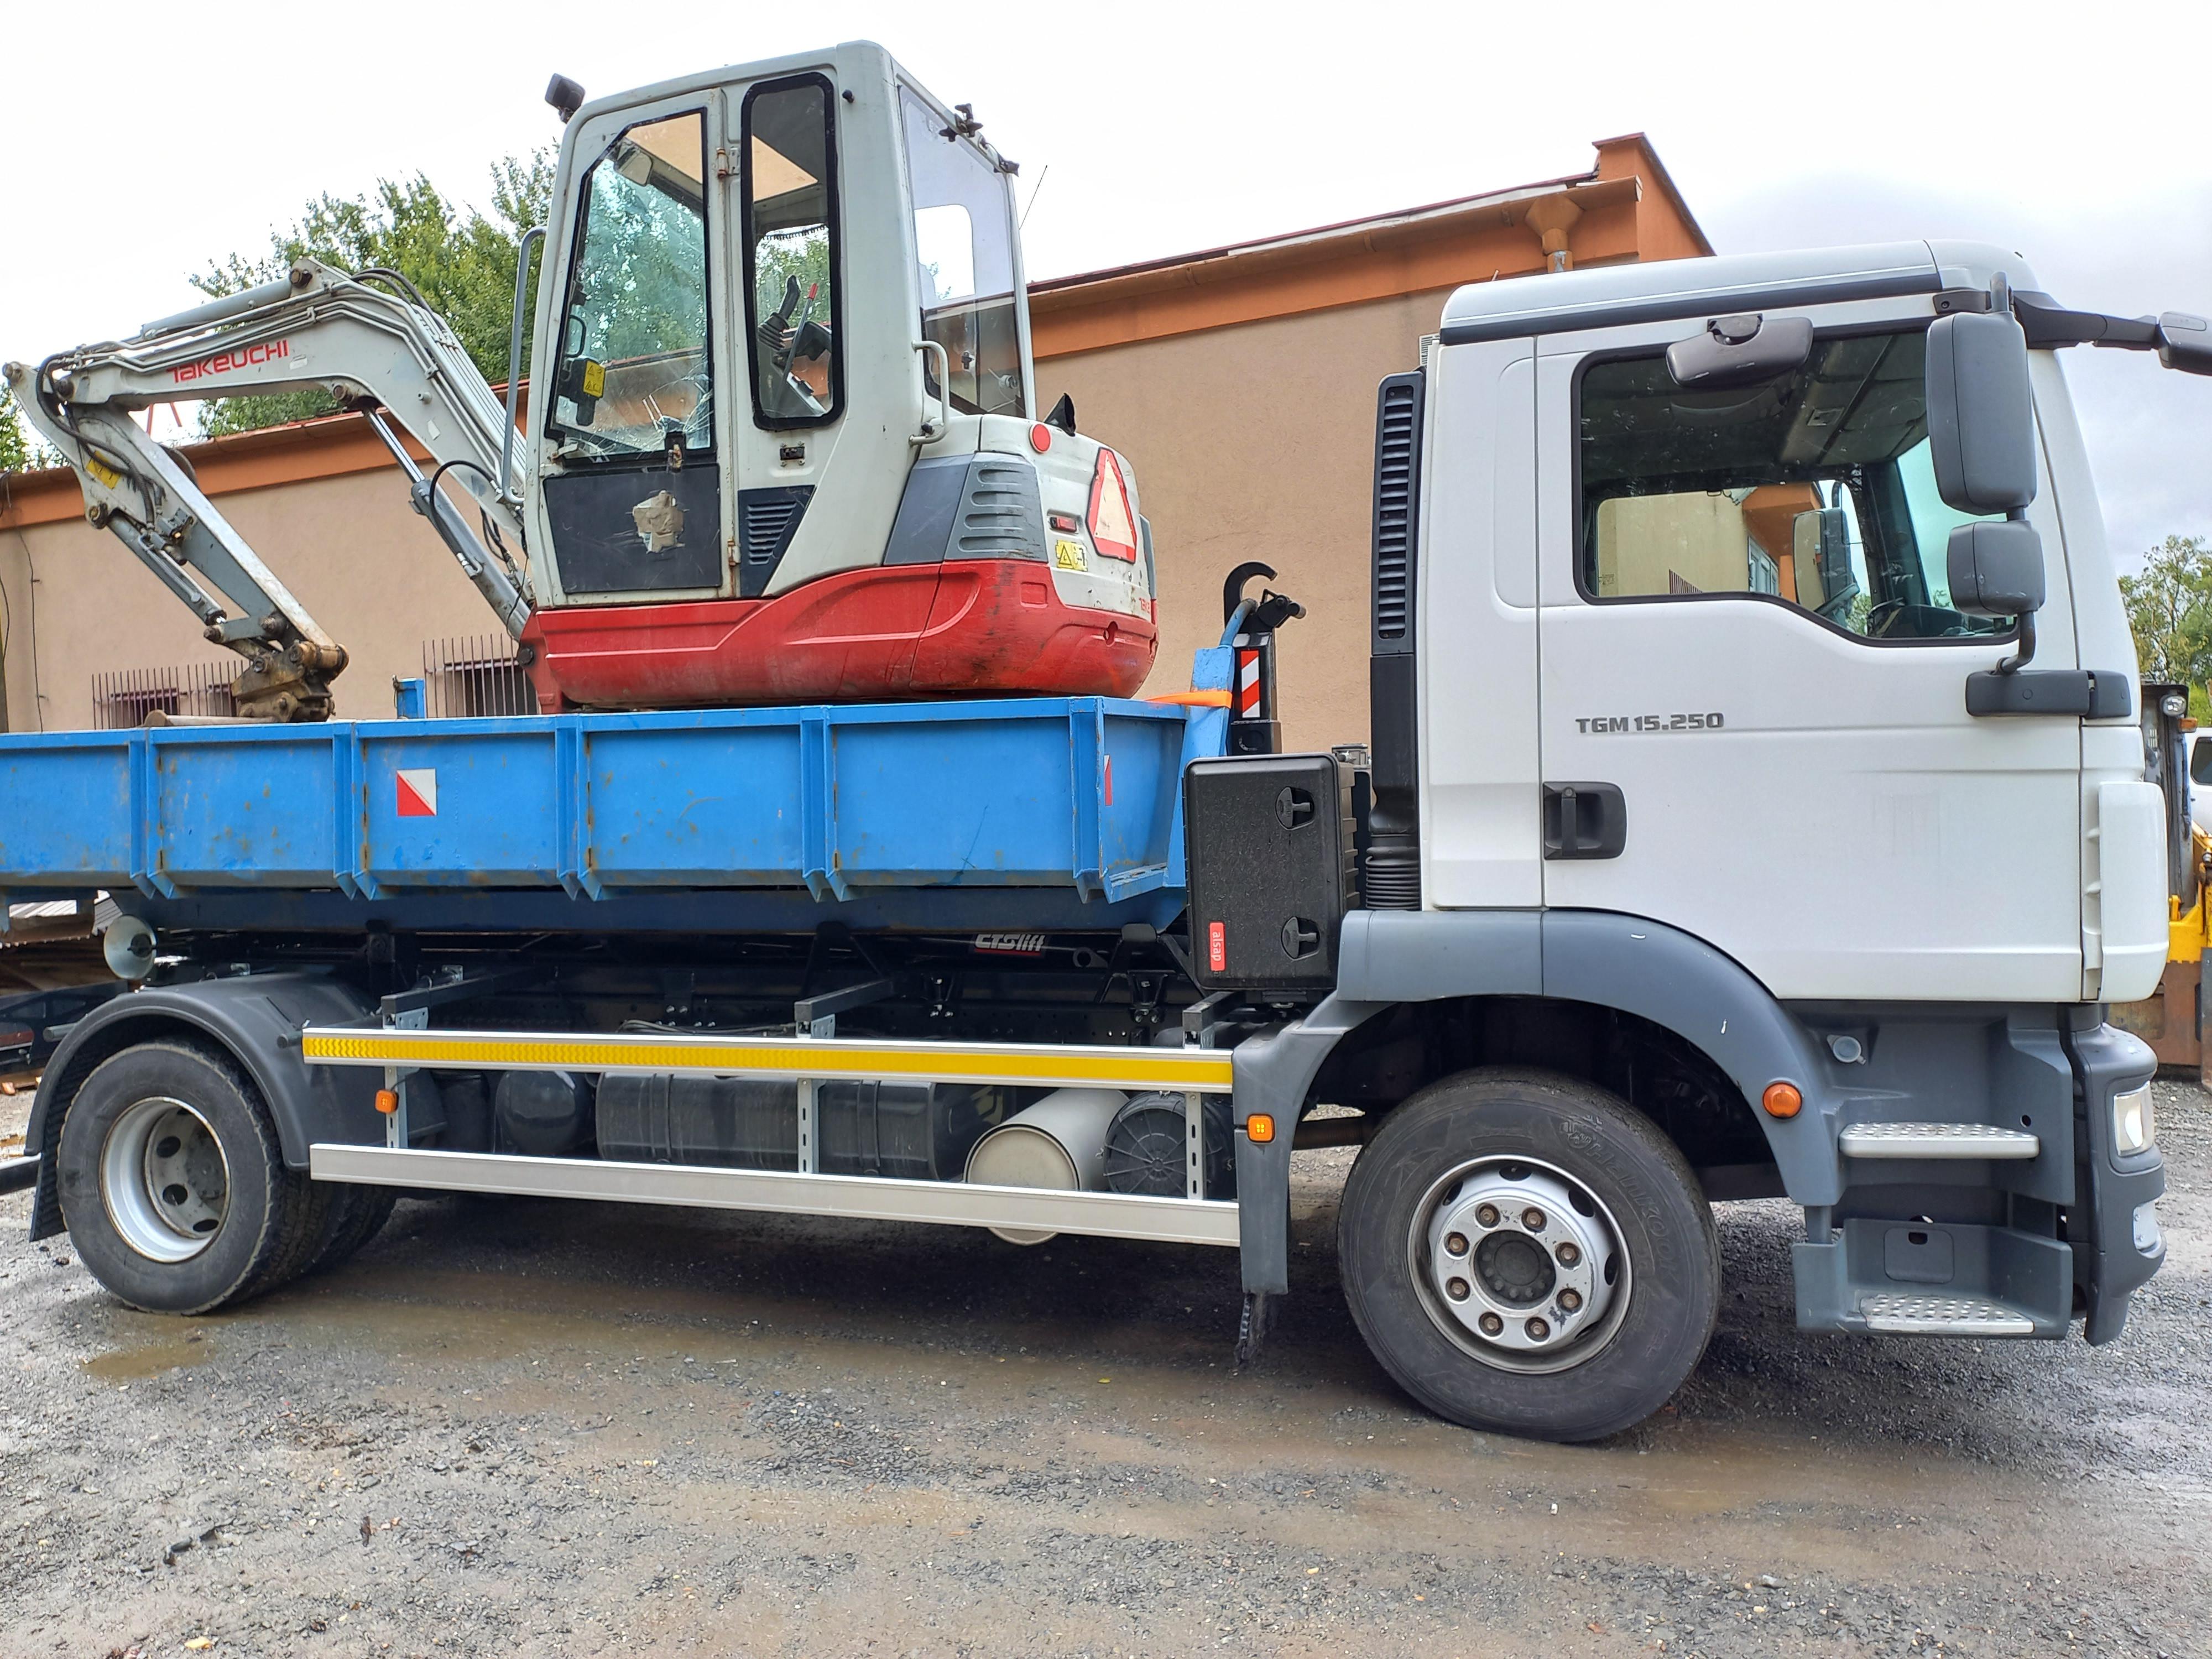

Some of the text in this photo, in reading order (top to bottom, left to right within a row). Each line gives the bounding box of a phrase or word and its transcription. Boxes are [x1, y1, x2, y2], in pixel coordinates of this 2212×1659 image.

[1575, 712, 1724, 733] TGM 15.250
[1212, 931, 1223, 961] alsap
